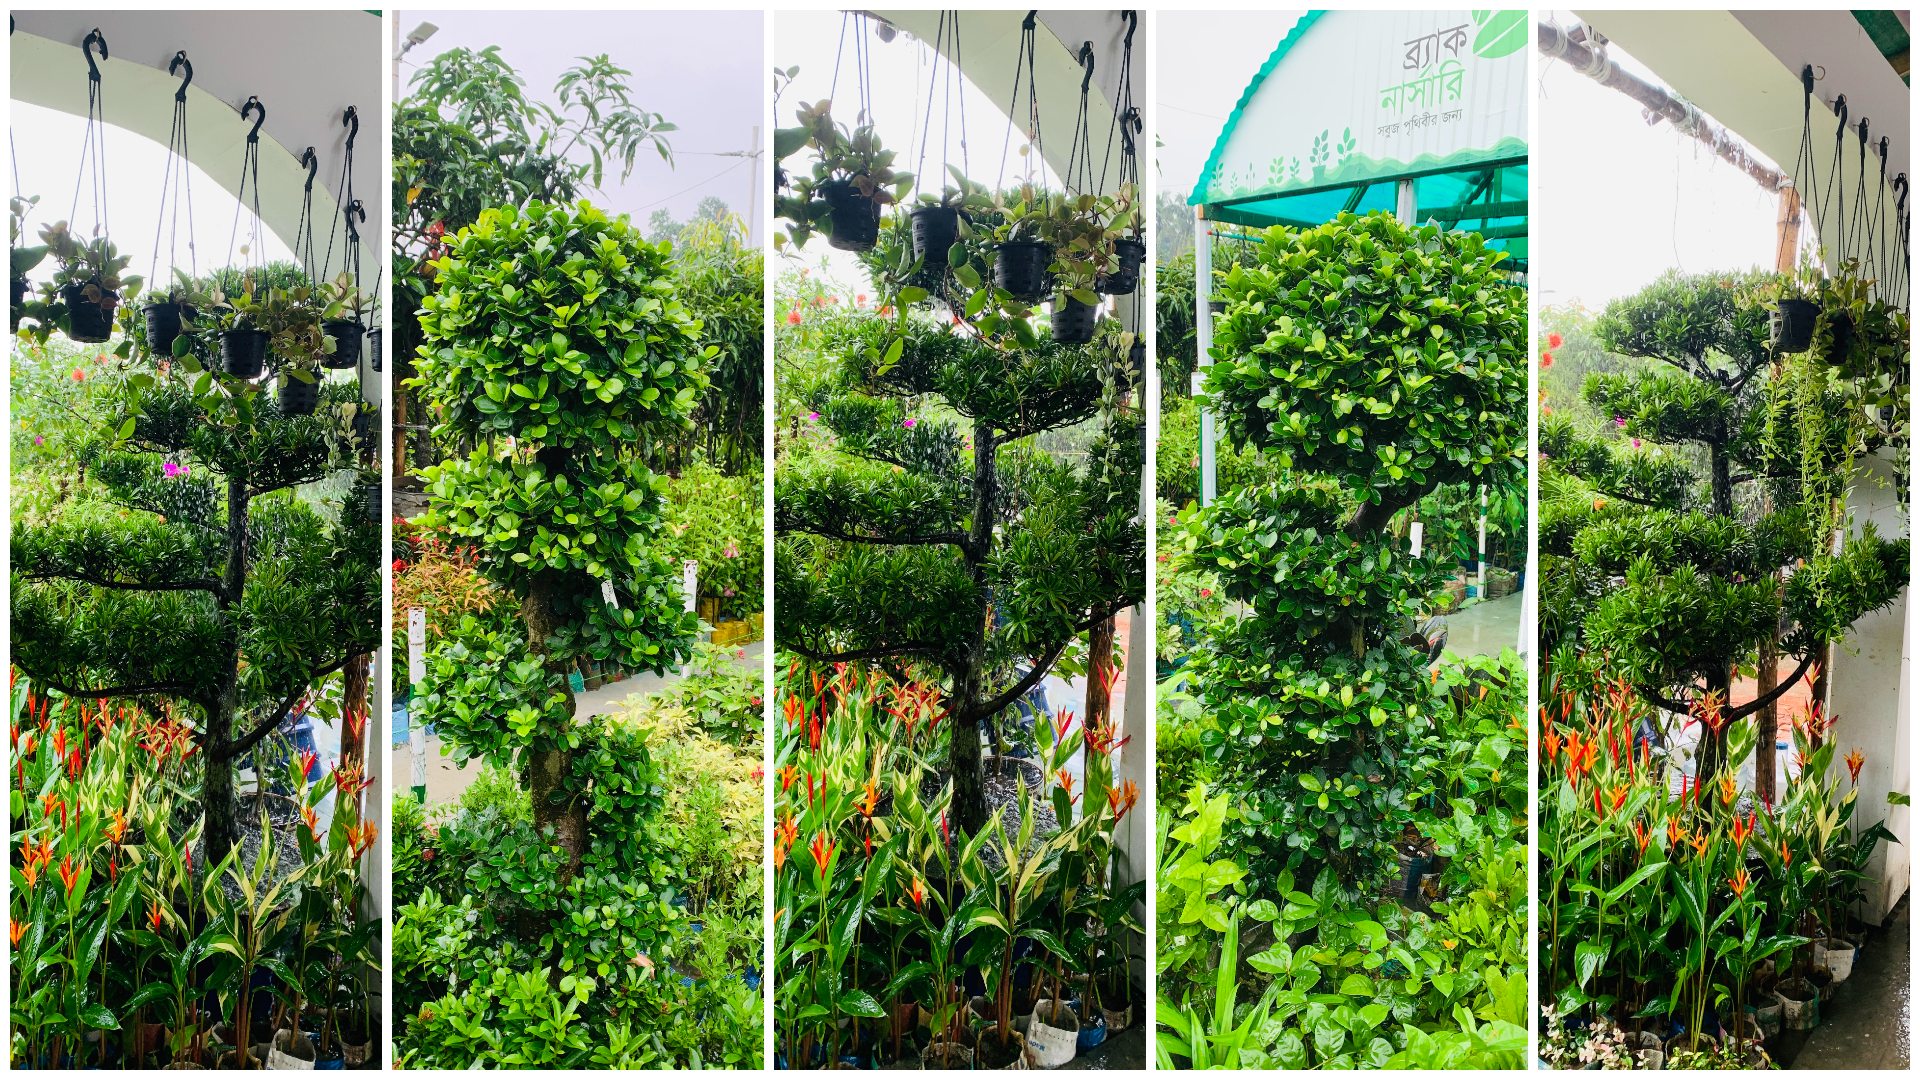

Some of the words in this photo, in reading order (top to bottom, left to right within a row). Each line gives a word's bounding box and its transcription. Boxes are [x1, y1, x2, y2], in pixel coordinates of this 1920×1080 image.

[1403, 23, 1470, 70] ব্র্যাক
[1380, 59, 1466, 116] নার্সারি
[1377, 122, 1400, 138] সবুজ
[1403, 111, 1438, 136] পৃথিবীর
[1441, 108, 1463, 123] জন্য
